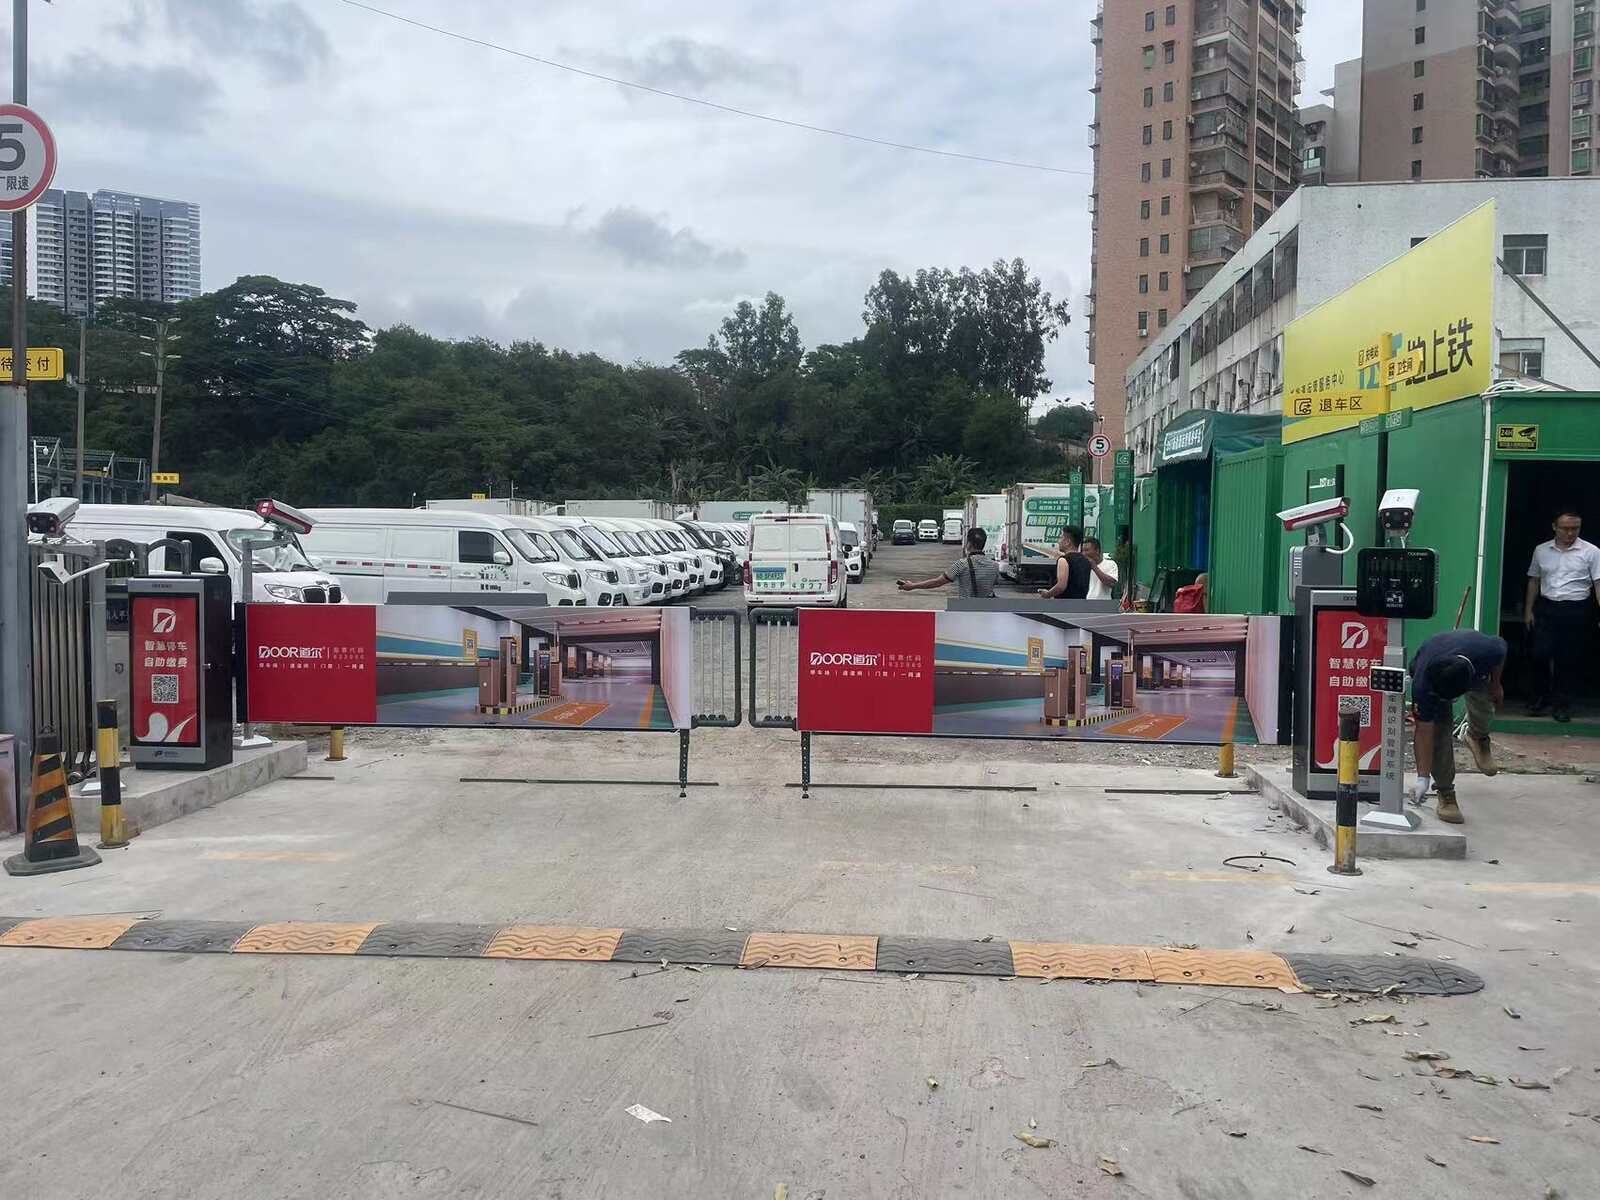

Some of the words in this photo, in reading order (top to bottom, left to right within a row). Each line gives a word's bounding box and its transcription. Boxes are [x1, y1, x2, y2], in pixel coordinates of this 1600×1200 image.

[0, 123, 26, 172] 5
[1319, 396, 1363, 412] 退车区
[1095, 439, 1105, 450] 5
[144, 640, 188, 652] 智慧停车
[144, 657, 188, 668] 自助缴费
[1328, 658, 1382, 670] 智慧停车
[1329, 676, 1369, 688] 自助缴
